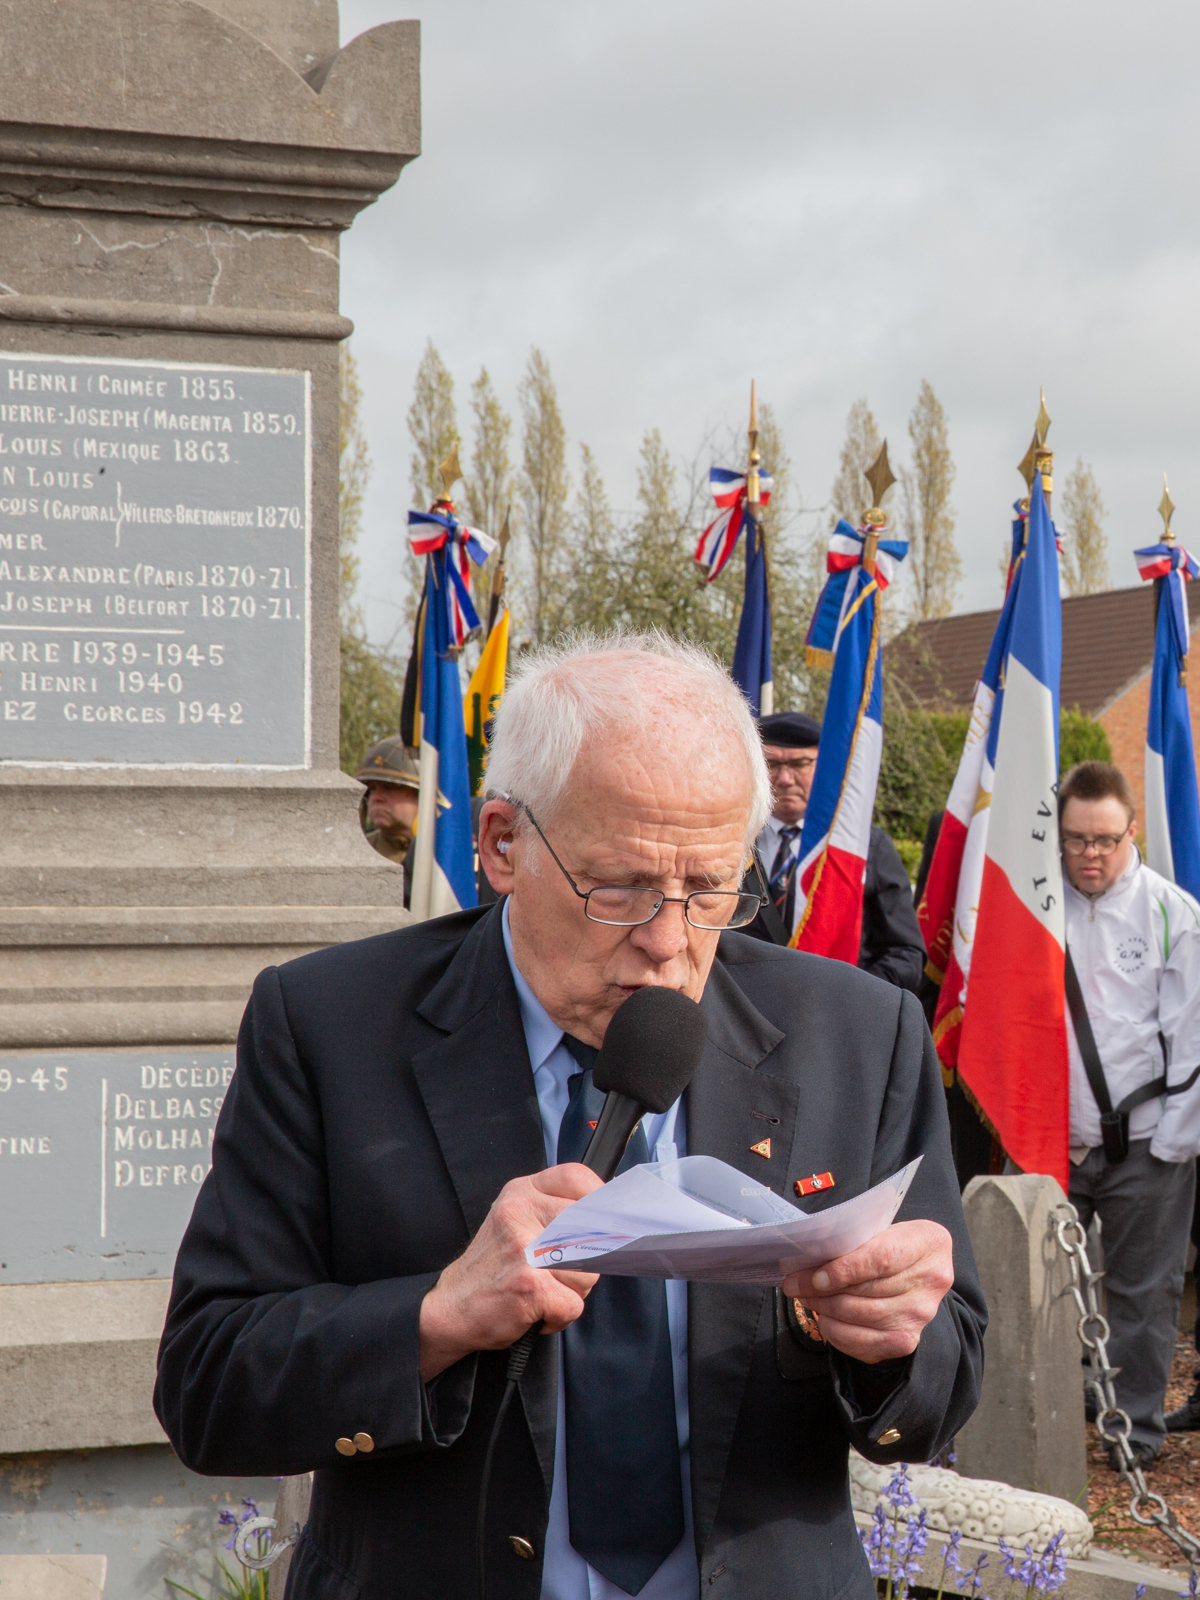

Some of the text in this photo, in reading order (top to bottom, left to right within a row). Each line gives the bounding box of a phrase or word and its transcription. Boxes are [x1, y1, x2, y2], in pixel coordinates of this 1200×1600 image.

[22, 672, 96, 692] HENRI
[119, 671, 182, 693] 1940
[64, 703, 165, 723] GEORGES
[179, 702, 242, 724] 1942
[115, 1160, 212, 1186] DEFRO
